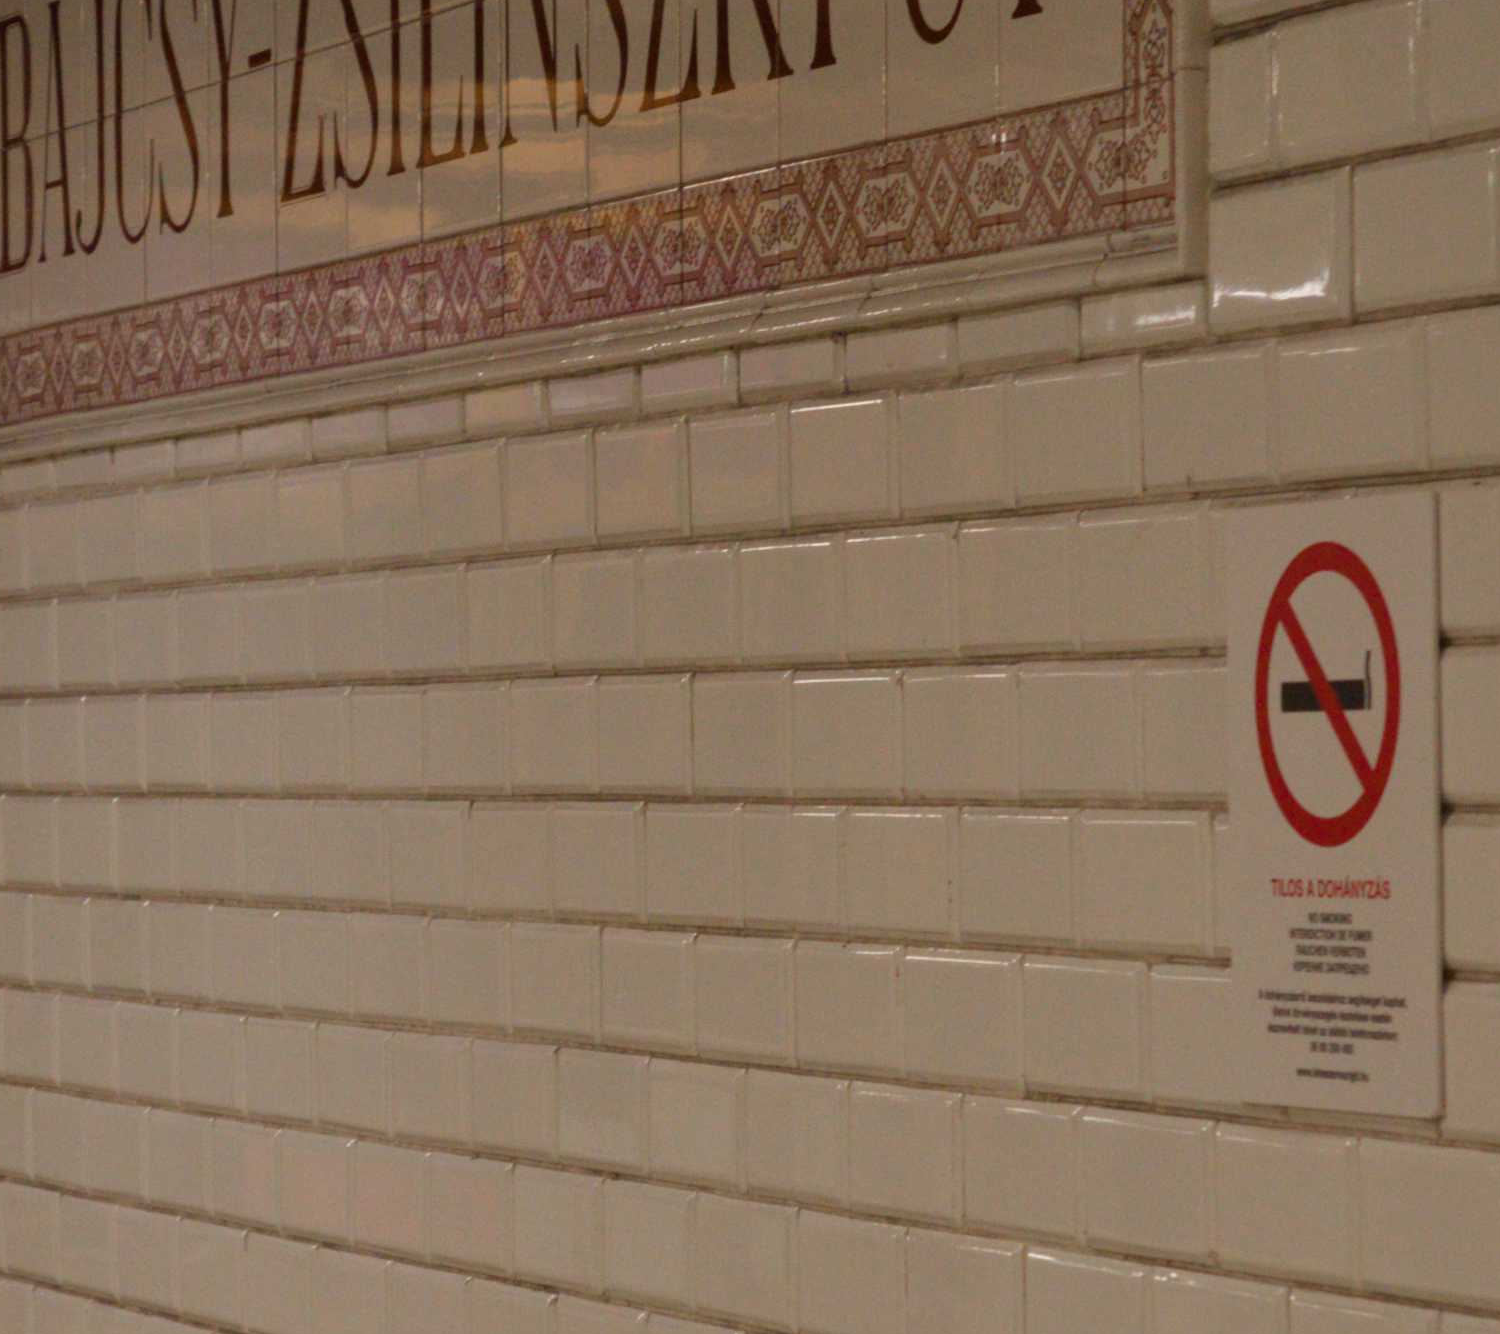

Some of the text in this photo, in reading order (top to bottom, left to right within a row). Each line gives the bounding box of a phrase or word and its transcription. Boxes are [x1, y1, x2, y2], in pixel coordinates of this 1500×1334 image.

[1271, 874, 1392, 900] TILOS A DOHÁNYZÁS
